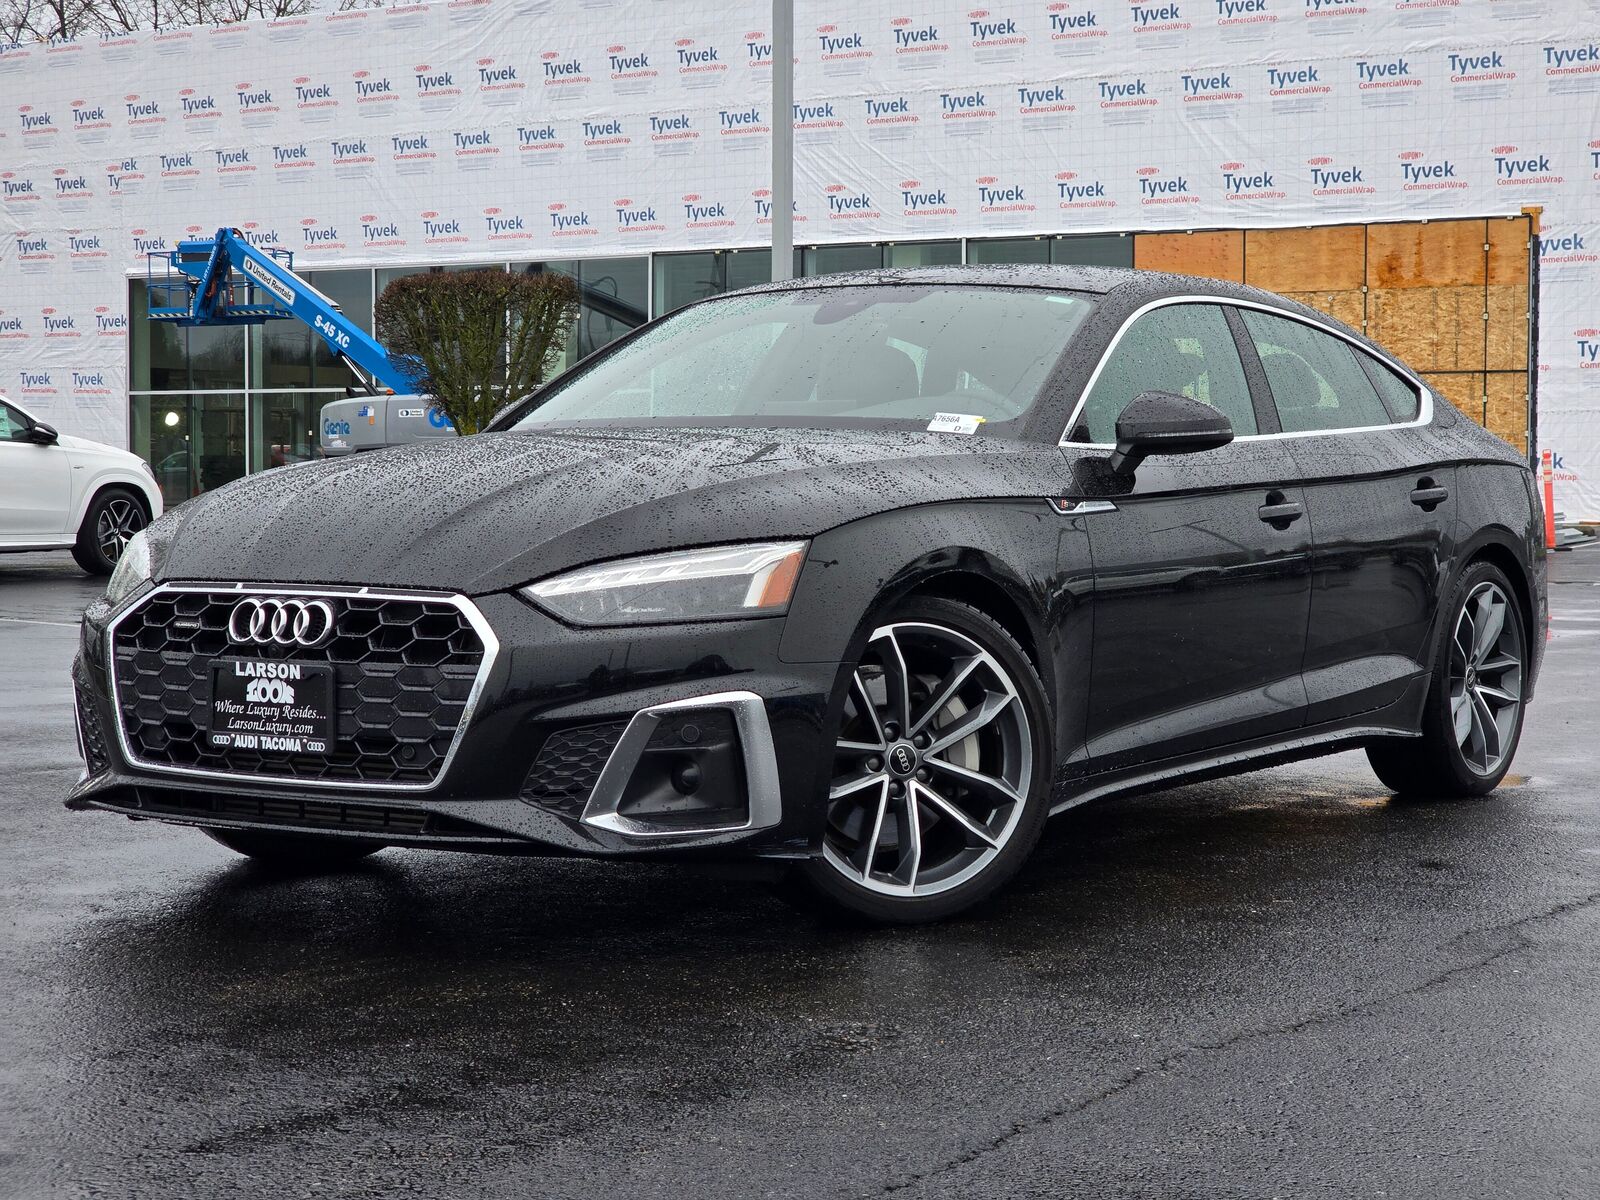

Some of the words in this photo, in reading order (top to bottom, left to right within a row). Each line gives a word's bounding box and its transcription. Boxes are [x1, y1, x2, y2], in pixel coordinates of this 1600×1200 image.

[1049, 11, 1098, 33] Tyvek
[1131, 3, 1179, 24] Tyvek
[894, 26, 937, 47] Tyvek
[970, 19, 1015, 40] Tyvek
[819, 33, 861, 52] Tyvek
[609, 53, 650, 72] Tyvek
[677, 47, 717, 66] Tyvek
[1448, 51, 1502, 75] Tyvek
[1543, 45, 1600, 67] Tyvek
[479, 66, 515, 84] Tyvek
[543, 60, 581, 78] Tyvek
[1267, 66, 1320, 88] Tyvek
[1357, 59, 1408, 81] Tyvek
[355, 79, 390, 96] Tyvek
[416, 72, 452, 89] Tyvek
[1181, 73, 1230, 95] Tyvek
[238, 90, 271, 106] Tyvek
[296, 84, 330, 101] Tyvek
[1018, 86, 1063, 107] Tyvek
[1098, 79, 1145, 101] Tyvek
[127, 101, 159, 117] Tyvek
[181, 96, 214, 112] Tyvek
[865, 97, 907, 117] Tyvek
[940, 92, 984, 112] Tyvek
[20, 113, 51, 128] Tyvek
[73, 107, 103, 123] Tyvek
[719, 109, 759, 128] Tyvek
[792, 103, 833, 122] Tyvek
[582, 120, 621, 139] Tyvek
[650, 114, 689, 133] Tyvek
[454, 131, 490, 149] Tyvek
[517, 127, 554, 143] Tyvek
[273, 145, 306, 161] Tyvek
[331, 140, 366, 157] Tyvek
[392, 136, 427, 154] Tyvek
[160, 154, 191, 169] Tyvek
[216, 150, 248, 166] Tyvek
[1495, 155, 1549, 178] Tyvek
[1311, 167, 1362, 188] Tyvek
[1401, 161, 1454, 183] Tyvek
[3, 180, 32, 194] Tyvek
[55, 177, 87, 191] Tyvek
[1058, 181, 1104, 202] Tyvek
[1139, 177, 1187, 197] Tyvek
[1223, 172, 1273, 193] Tyvek
[828, 194, 870, 212] Tyvek
[902, 190, 945, 209] Tyvek
[979, 185, 1023, 206] Tyvek
[551, 212, 588, 229] Tyvek
[616, 207, 655, 226] Tyvek
[685, 203, 724, 220] Tyvek
[362, 223, 397, 240] Tyvek
[424, 220, 459, 237] Tyvek
[486, 216, 522, 233] Tyvek
[69, 236, 99, 251] Tyvek
[134, 235, 166, 251] Tyvek
[245, 230, 278, 244] Tyvek
[304, 227, 337, 243] Tyvek
[17, 239, 46, 253] Tyvek
[1540, 233, 1584, 256] yvek
[252, 266, 271, 285] United
[271, 280, 293, 301] Rentals
[44, 316, 73, 331] Tyvek
[96, 315, 126, 329] Tyvek
[314, 315, 336, 337] S-45
[335, 330, 350, 348] XC
[20, 373, 50, 386] Tyvek
[73, 373, 103, 387] Tyvek
[324, 418, 351, 434] Genie
[235, 661, 301, 679] LARSON
[215, 700, 245, 714] Where
[246, 703, 280, 720] Luxury
[227, 717, 314, 735] LarsonLuxury.com
[234, 735, 258, 748] AUDI
[260, 737, 302, 752] TACOMA
